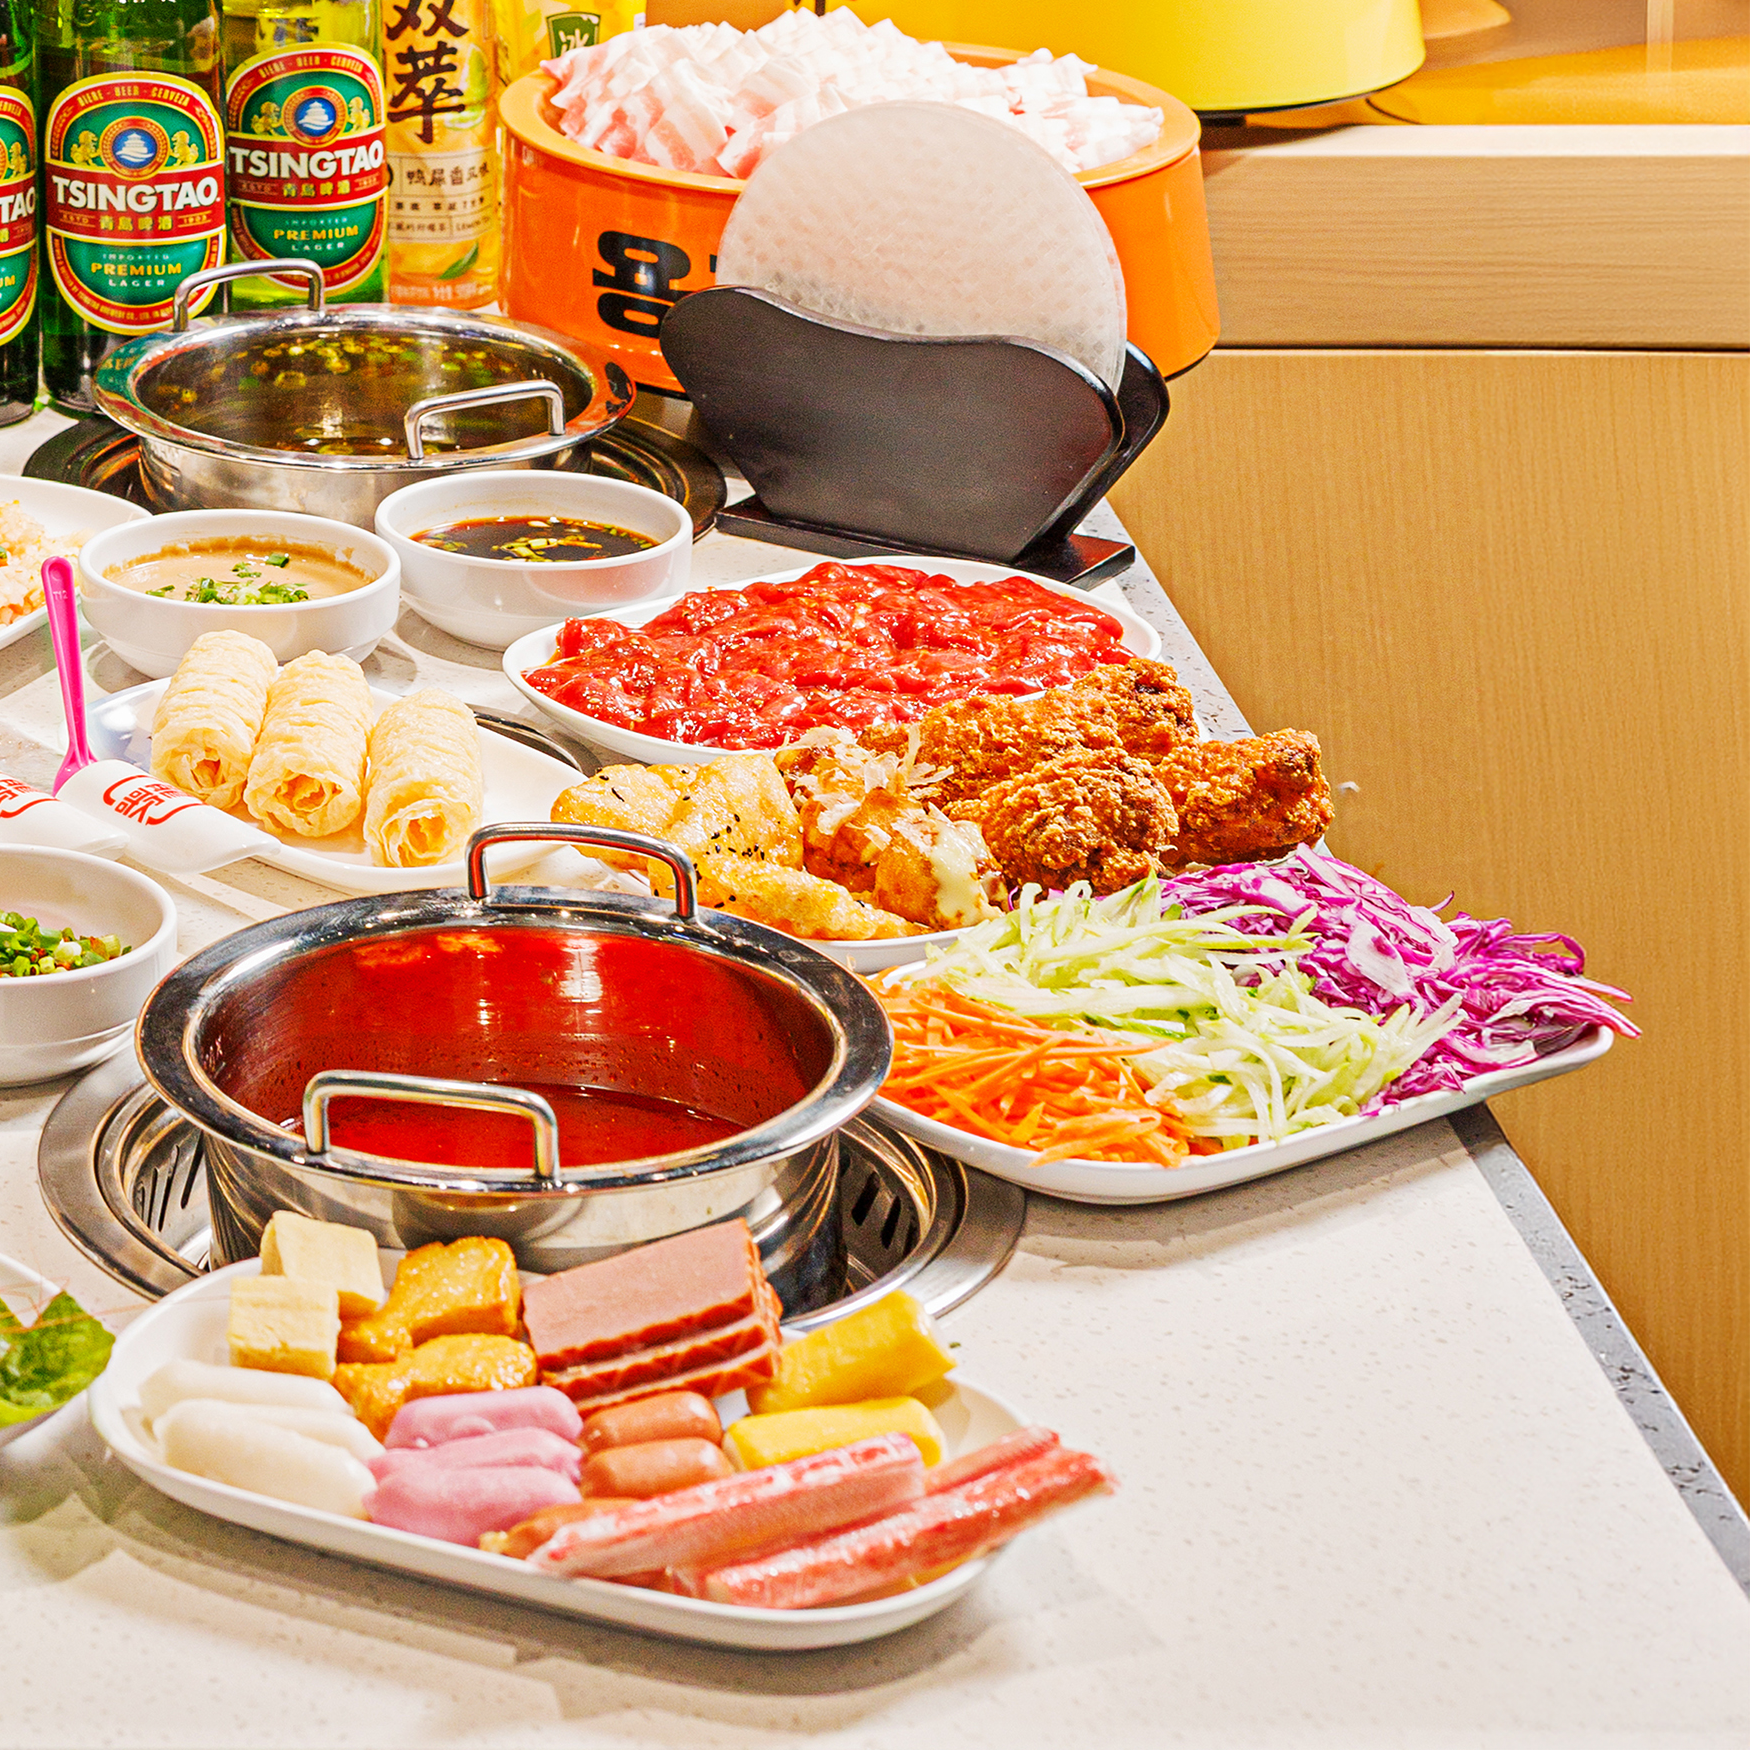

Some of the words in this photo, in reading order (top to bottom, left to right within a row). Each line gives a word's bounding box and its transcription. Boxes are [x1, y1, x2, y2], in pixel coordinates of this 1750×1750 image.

[229, 140, 383, 179] TSINGTAO
[52, 176, 218, 213] TSINGTAO
[273, 225, 359, 241] PREMIUM
[291, 242, 344, 251] LAGER
[91, 262, 181, 276] PREMIUM
[108, 279, 164, 287] LAGER
[593, 231, 691, 340] 용
